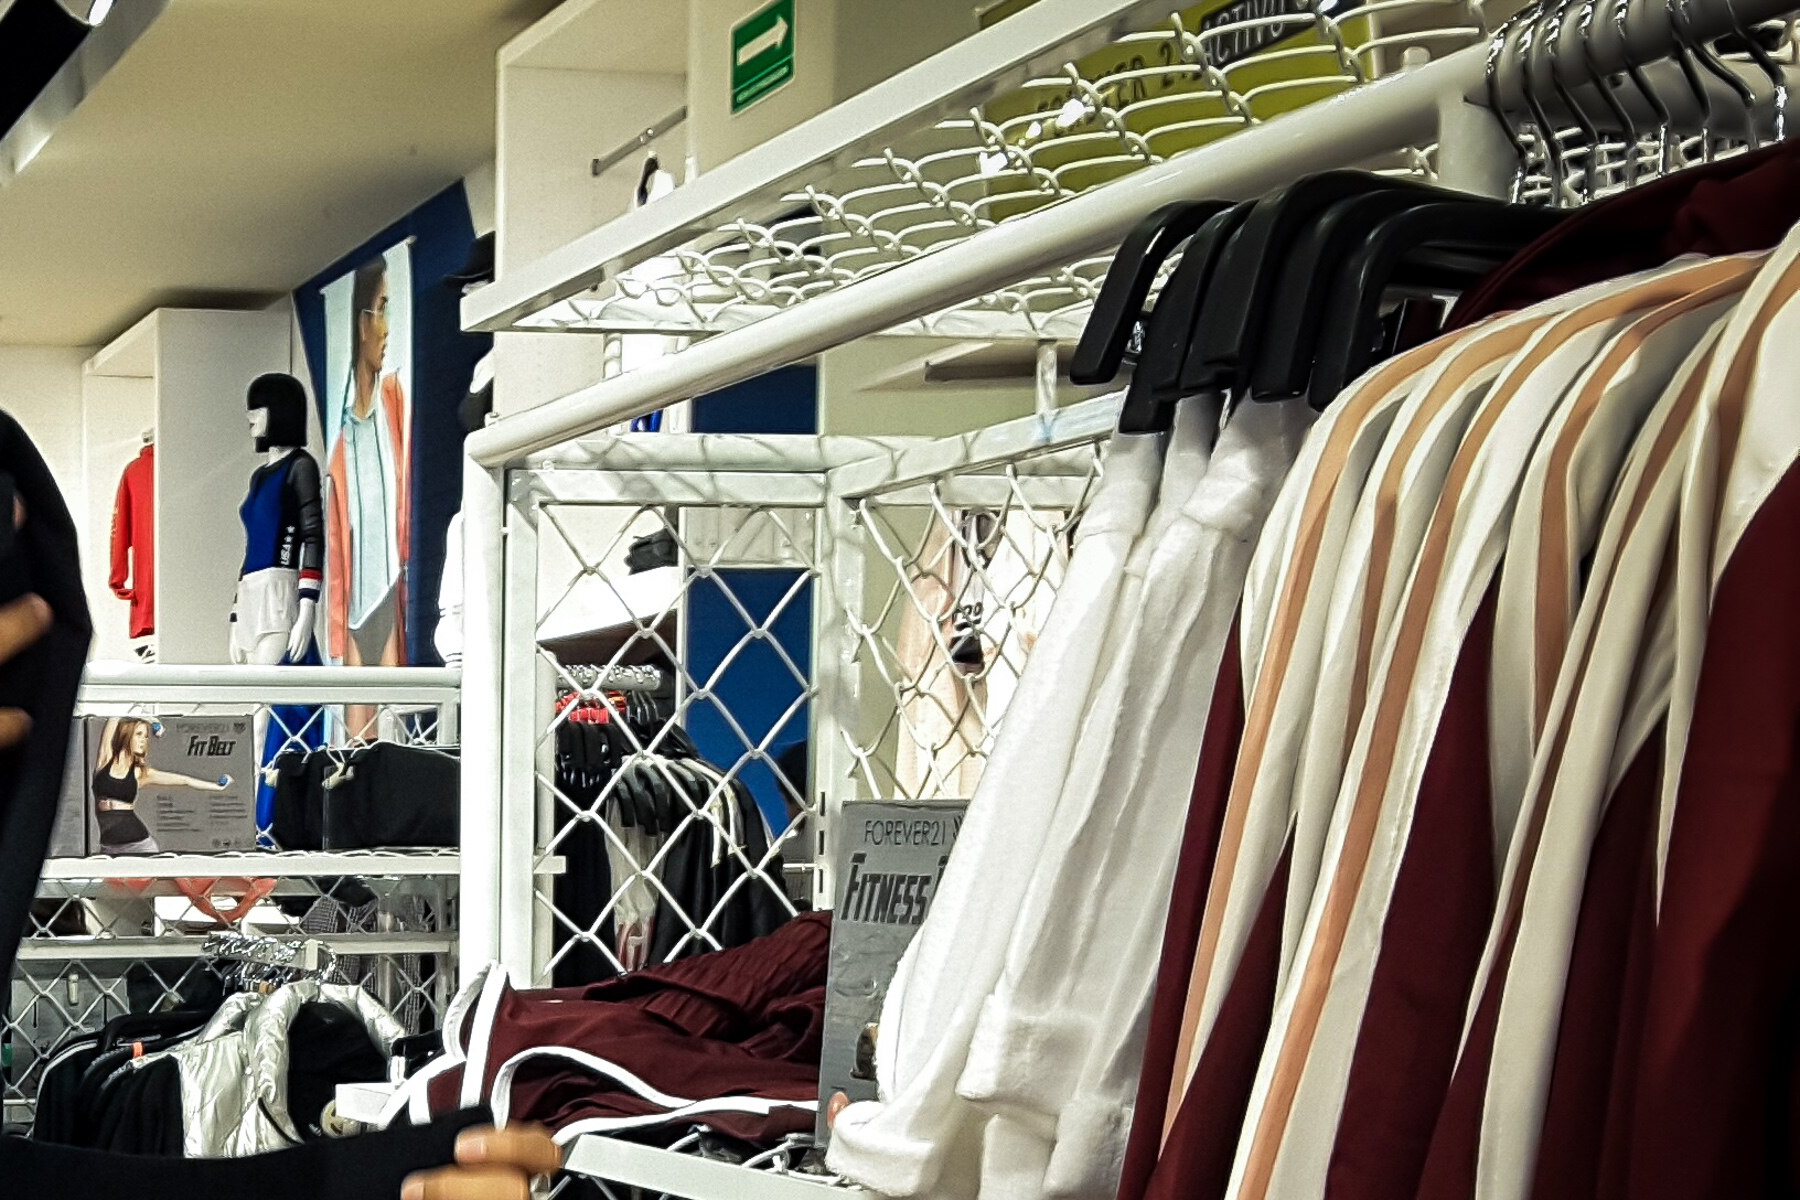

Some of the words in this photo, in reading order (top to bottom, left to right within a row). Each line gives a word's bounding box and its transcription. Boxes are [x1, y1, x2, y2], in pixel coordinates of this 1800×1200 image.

[280, 544, 291, 566] USA
[187, 735, 207, 756] FIT
[207, 735, 236, 756] BELT
[840, 852, 932, 925] FITNESS
